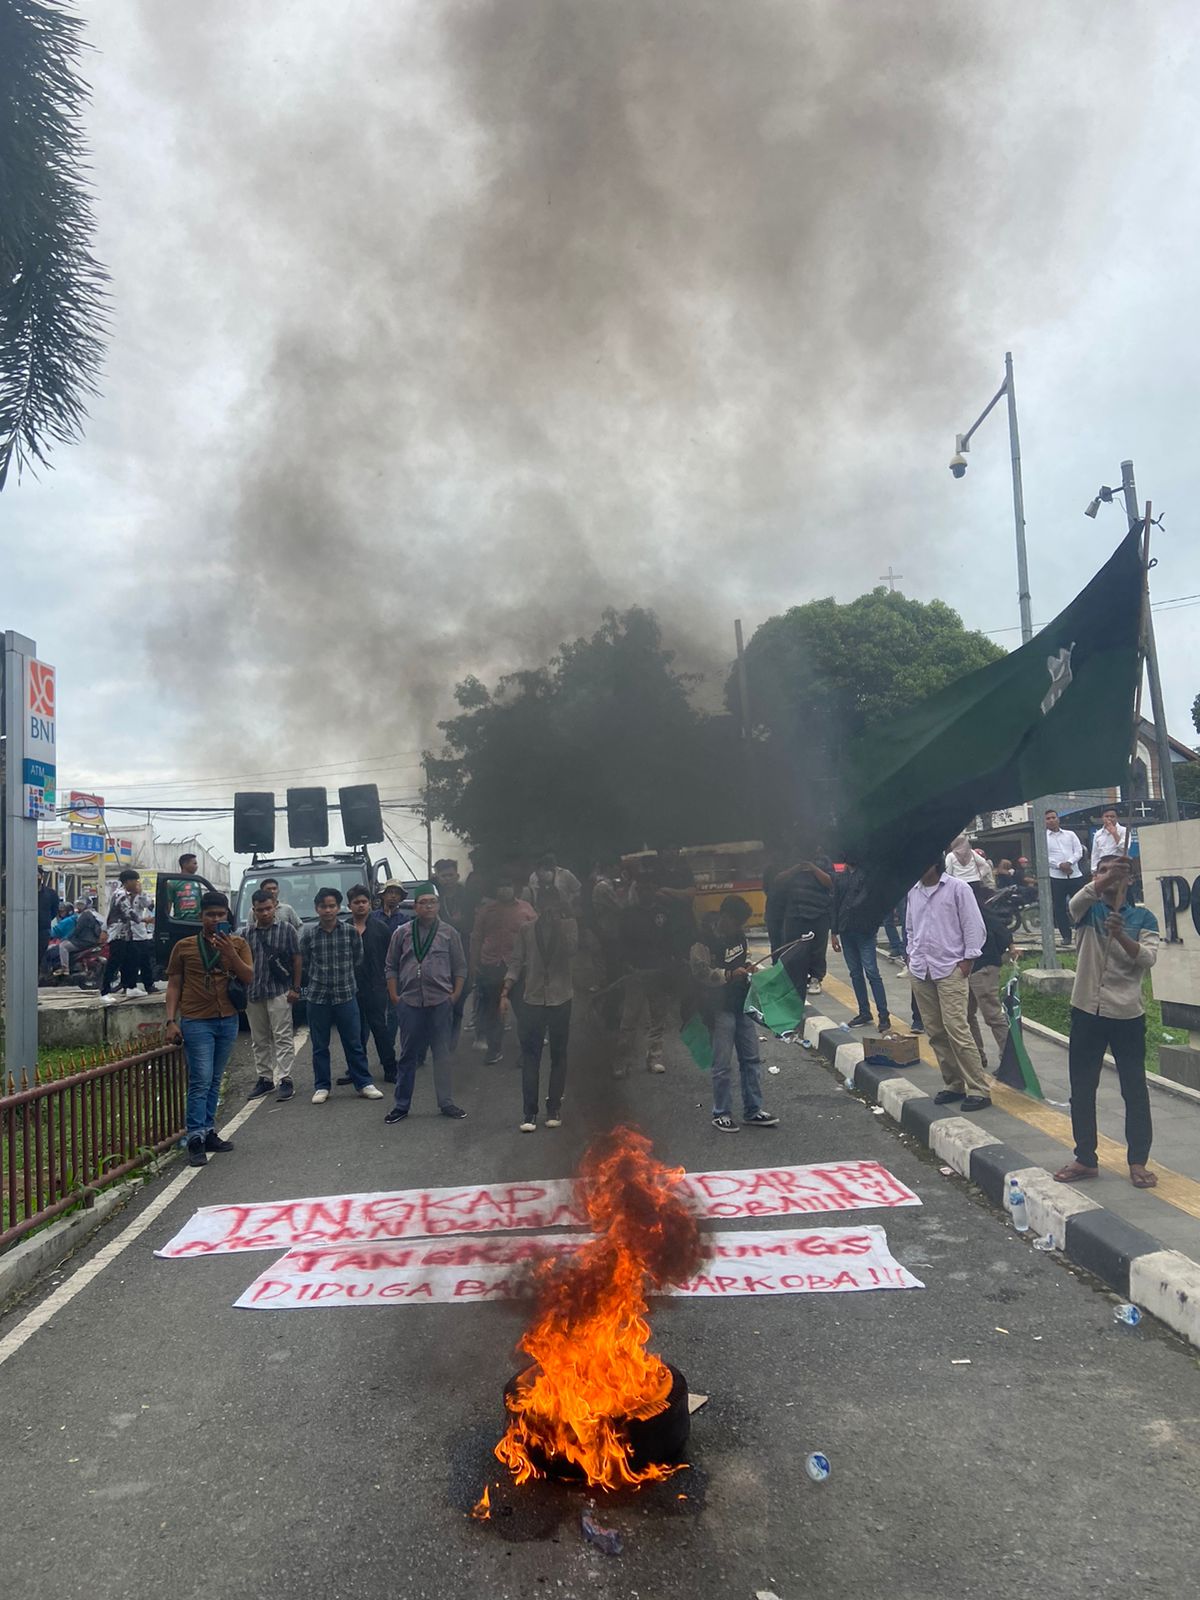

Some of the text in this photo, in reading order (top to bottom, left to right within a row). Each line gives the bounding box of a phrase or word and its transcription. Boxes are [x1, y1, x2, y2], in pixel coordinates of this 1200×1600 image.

[31, 715, 54, 744] BNI
[30, 764, 45, 777] ATM
[213, 1187, 548, 1237] TANGKAP
[251, 1280, 433, 1303] DIDUGA
